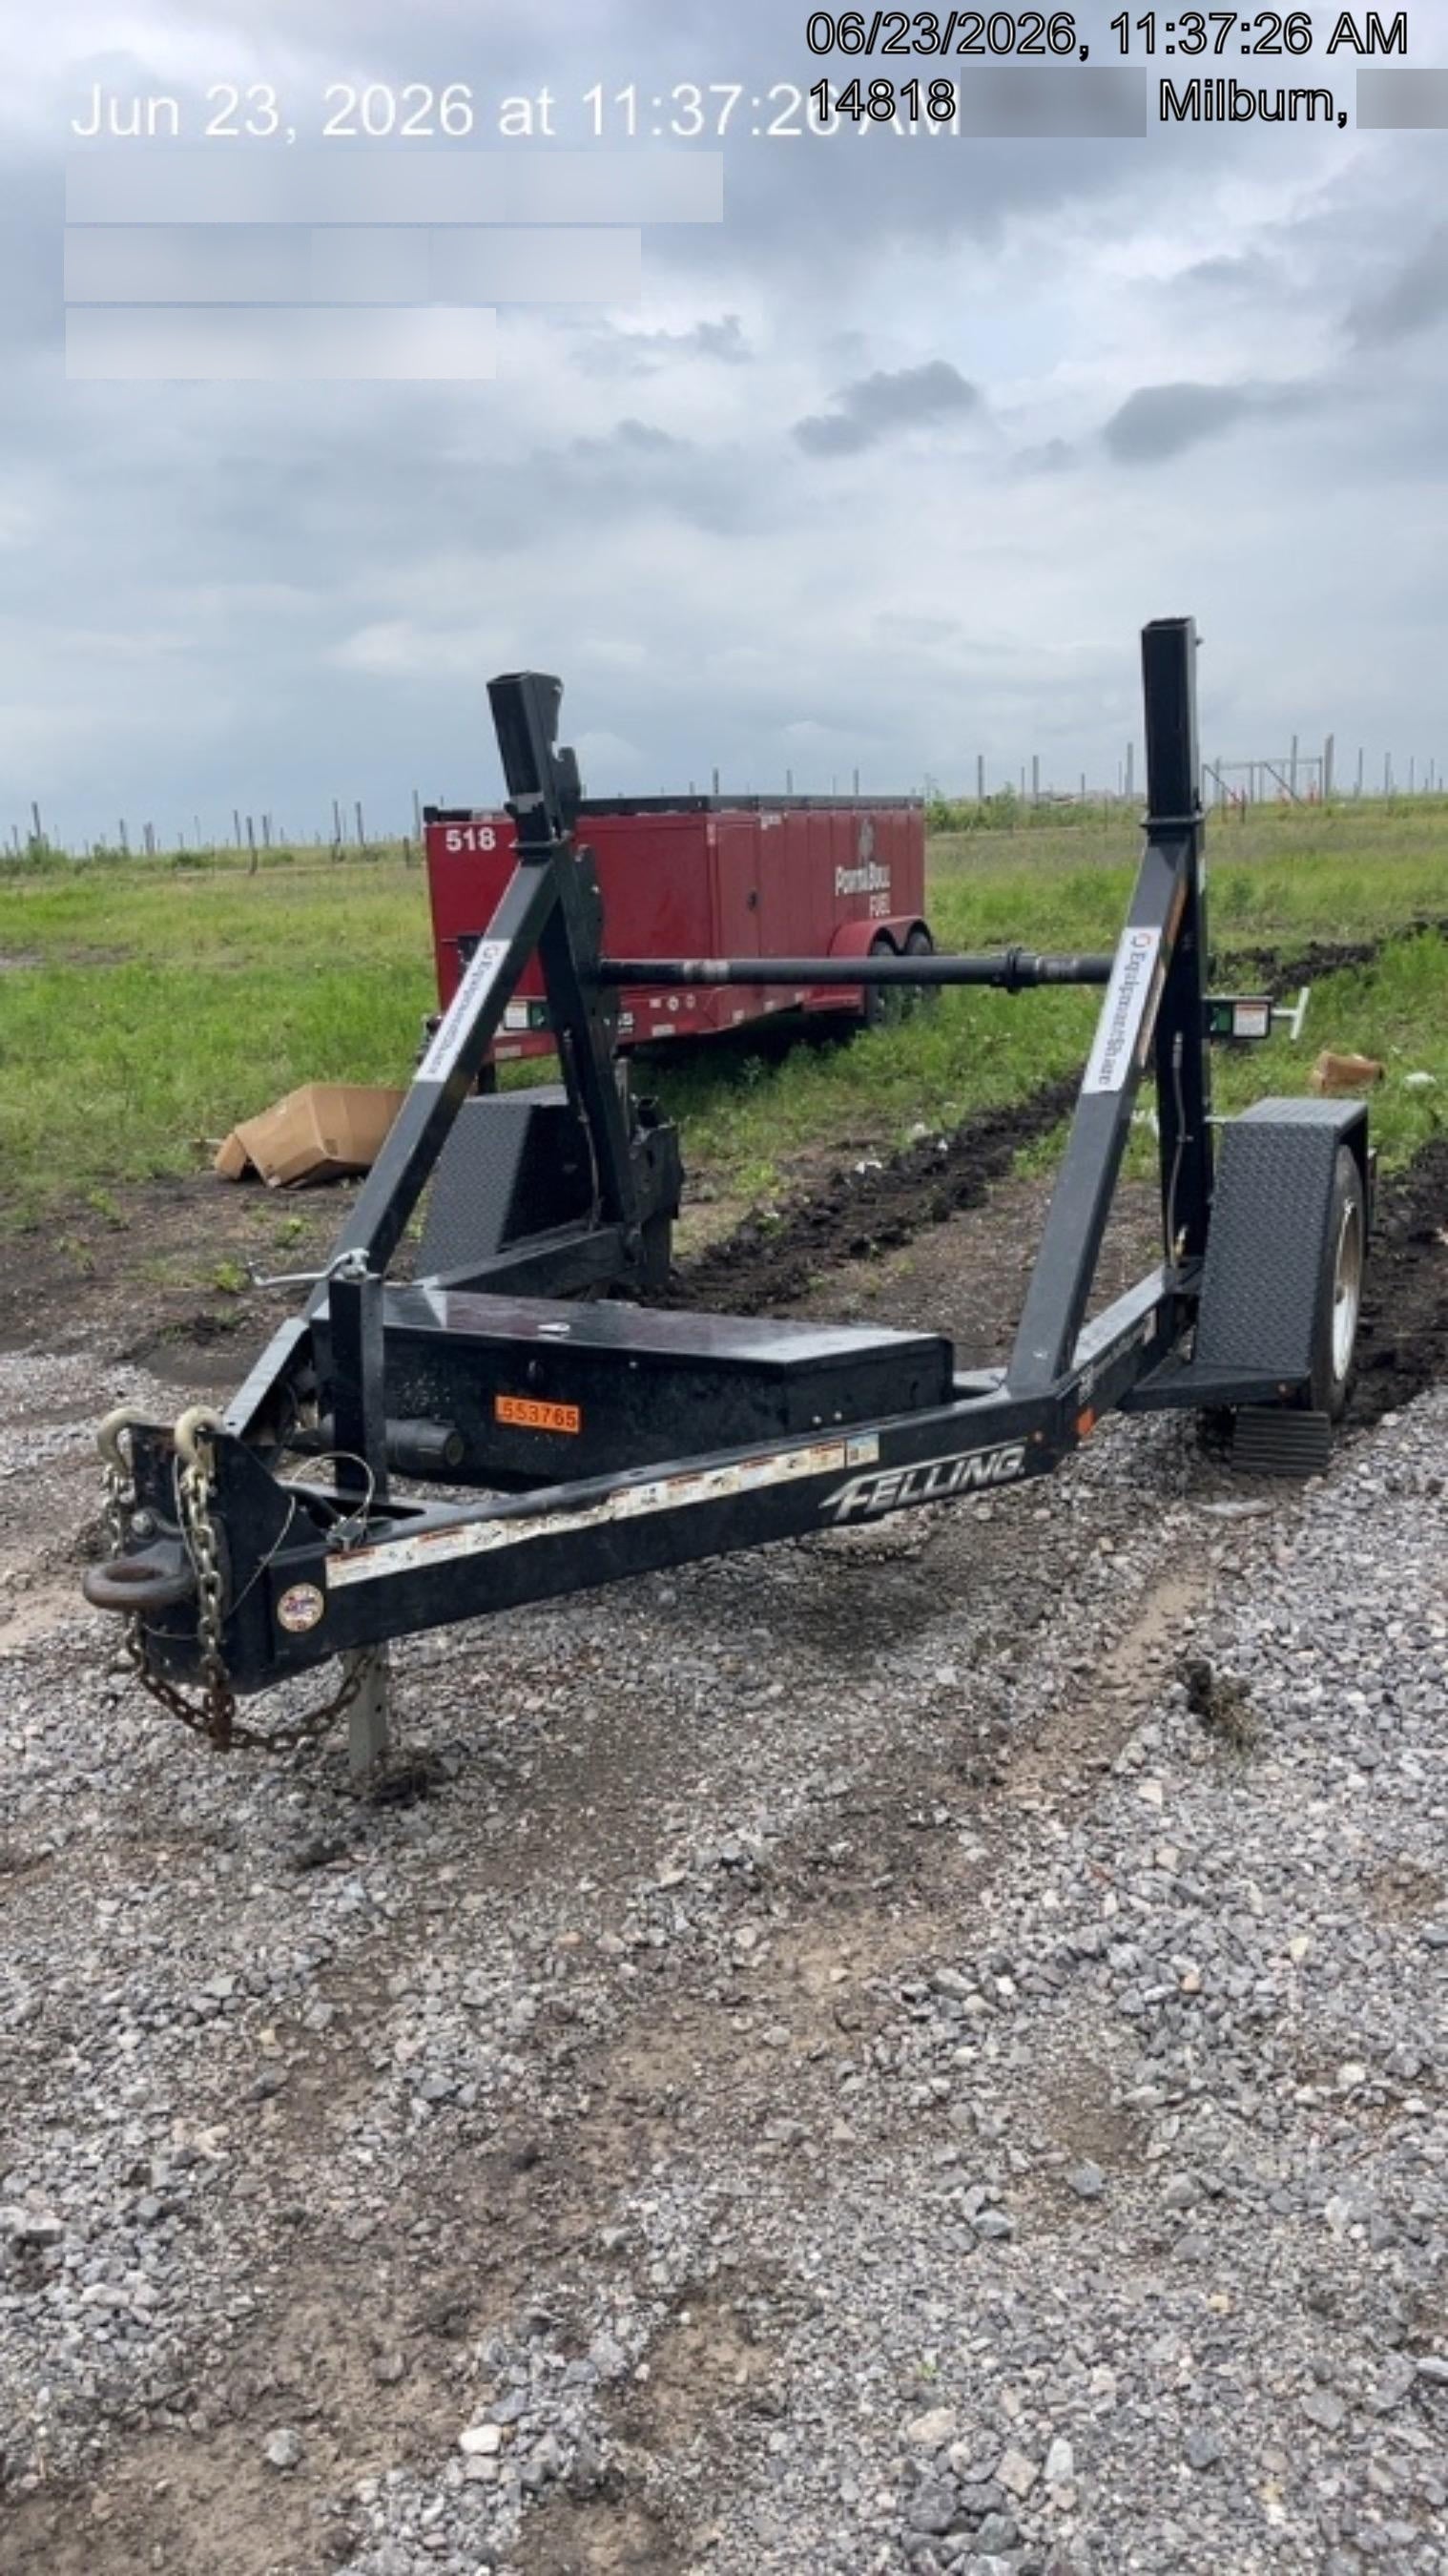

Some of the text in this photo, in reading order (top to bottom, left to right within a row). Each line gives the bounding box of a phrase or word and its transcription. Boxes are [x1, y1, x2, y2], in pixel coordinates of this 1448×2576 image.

[445, 826, 497, 852] 518
[502, 1399, 577, 1428] 553765
[818, 1436, 1025, 1521] FELLING
